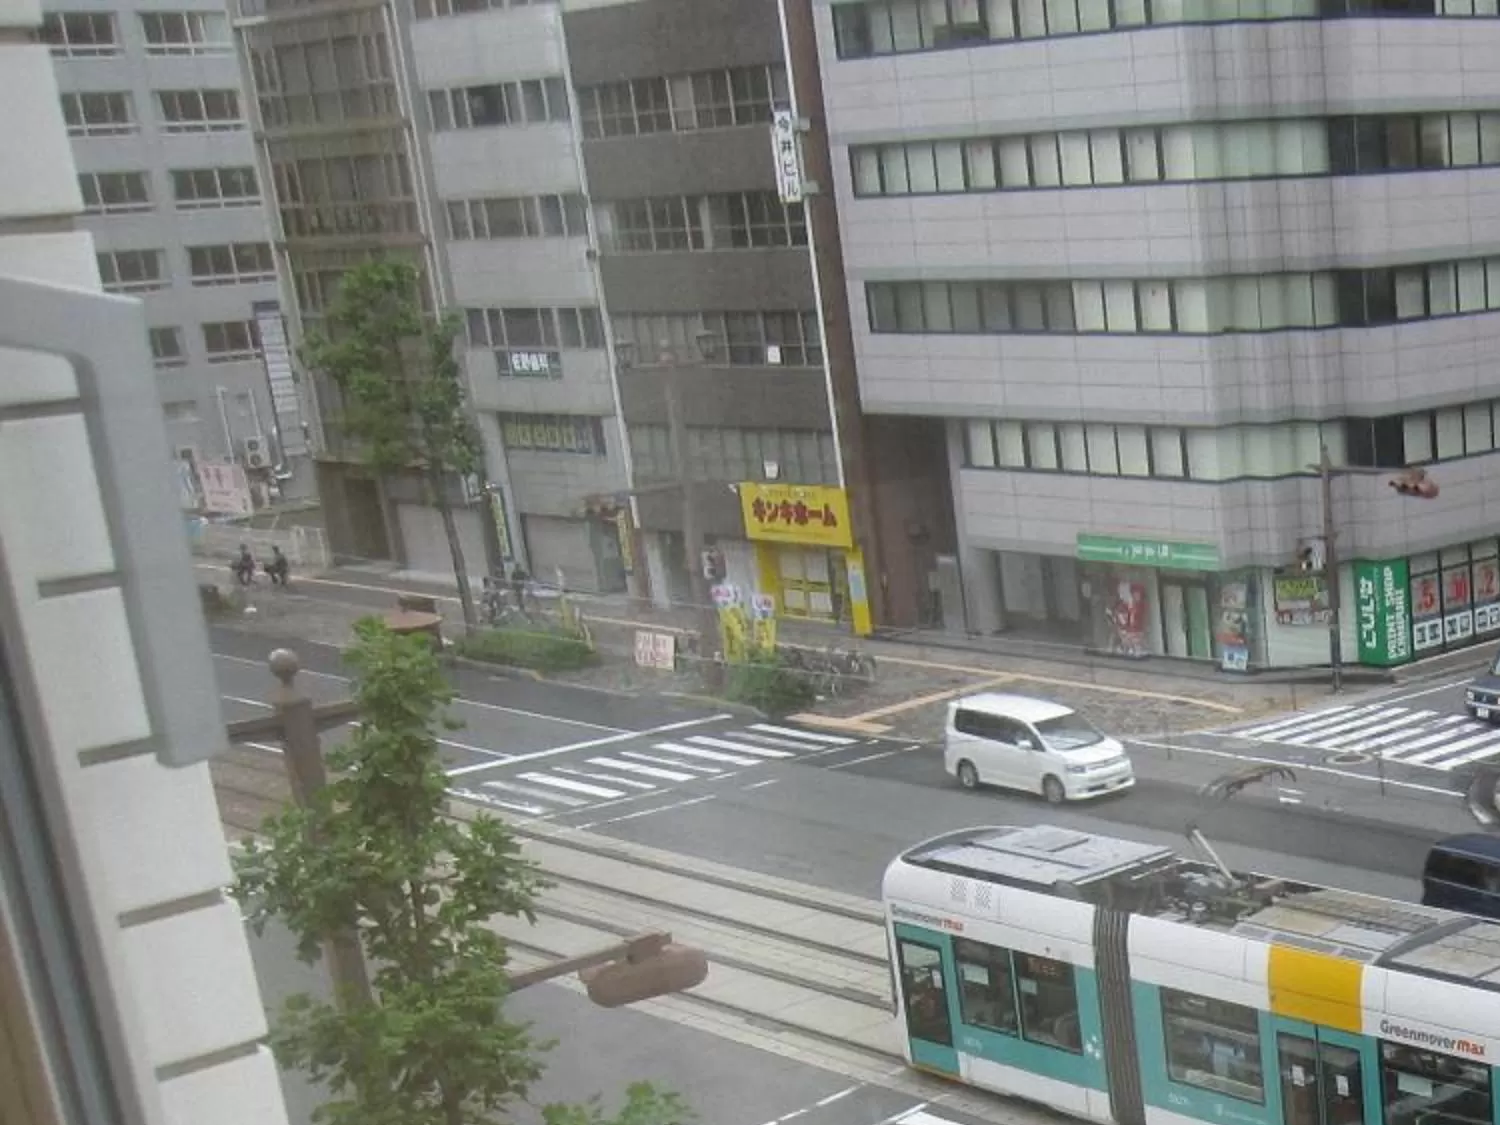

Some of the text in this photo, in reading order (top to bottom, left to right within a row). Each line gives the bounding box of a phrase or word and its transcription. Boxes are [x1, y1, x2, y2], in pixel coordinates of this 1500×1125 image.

[751, 496, 838, 529] キンキホーム
